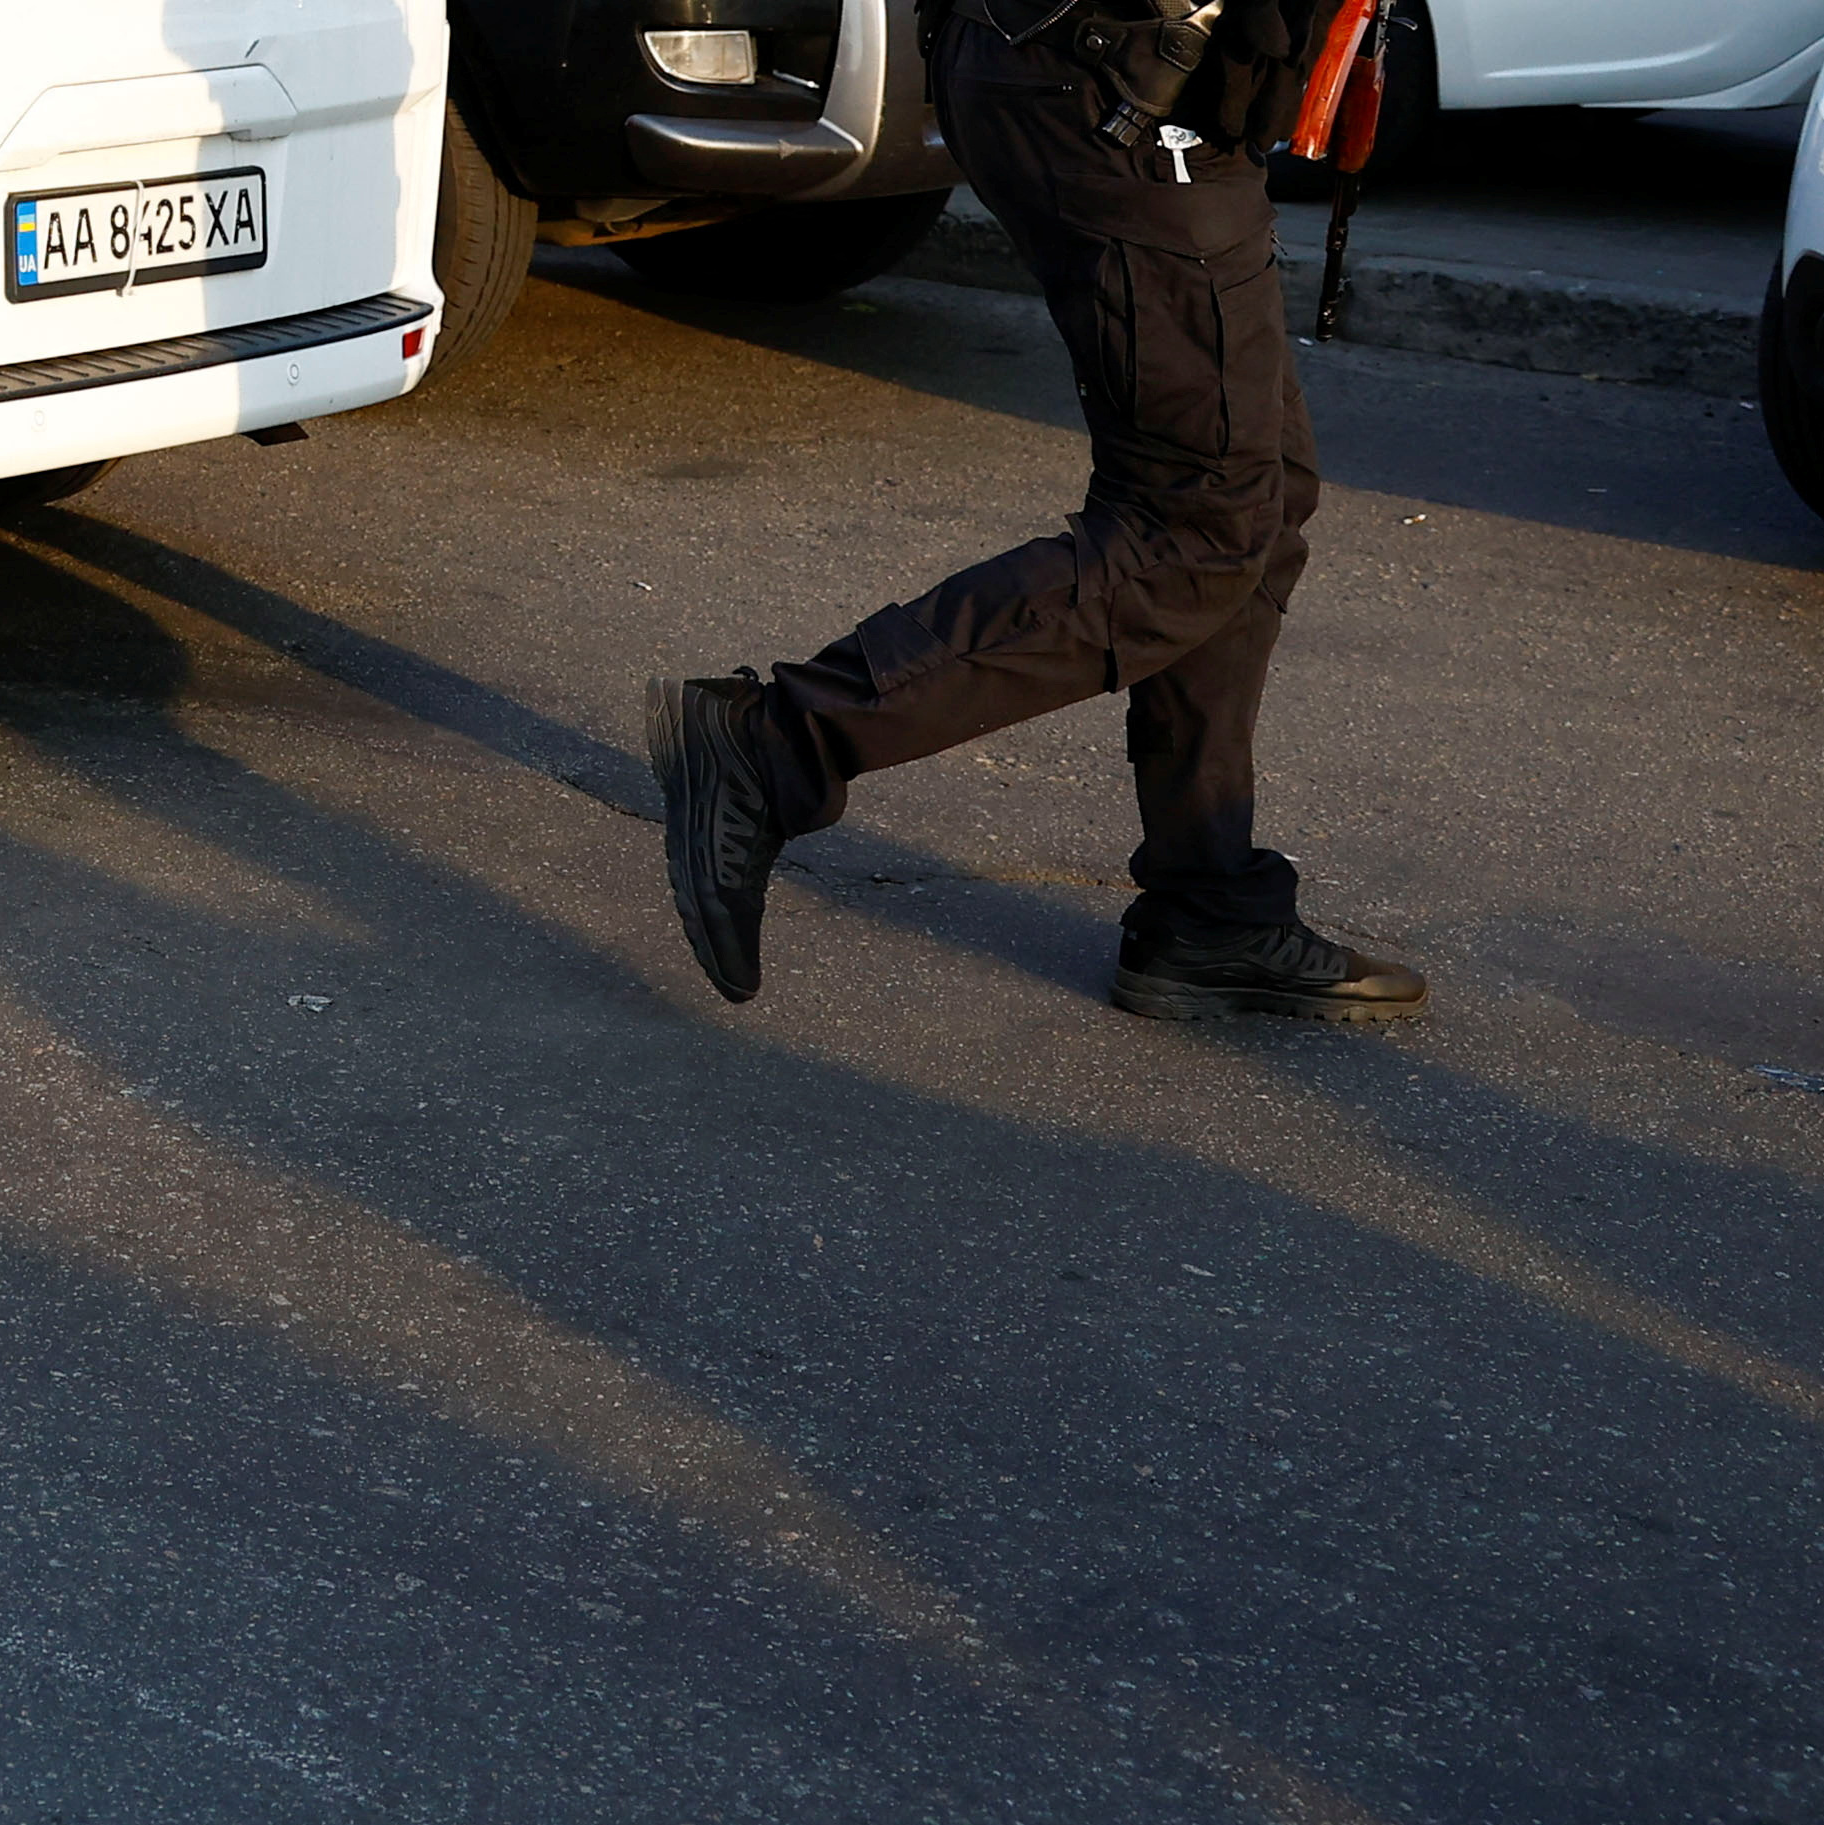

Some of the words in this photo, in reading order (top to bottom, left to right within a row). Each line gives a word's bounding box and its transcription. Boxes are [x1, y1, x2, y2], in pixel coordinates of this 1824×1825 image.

[43, 208, 98, 270] AA
[204, 188, 257, 249] XA
[18, 255, 38, 274] UA
